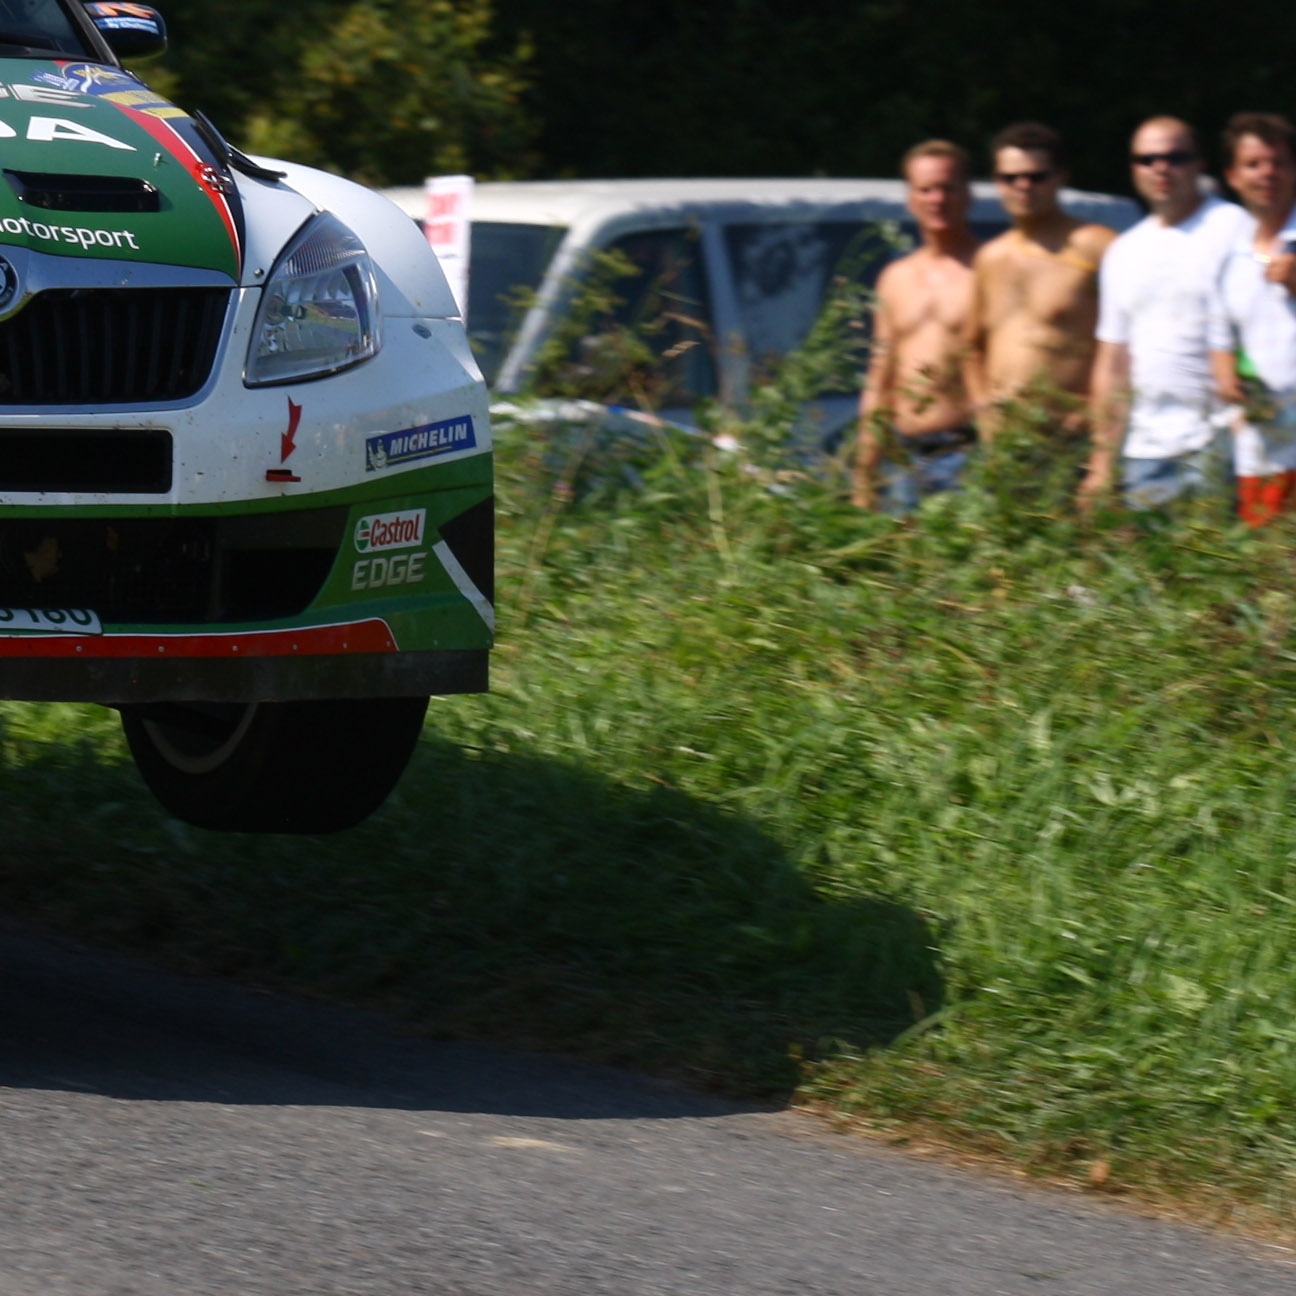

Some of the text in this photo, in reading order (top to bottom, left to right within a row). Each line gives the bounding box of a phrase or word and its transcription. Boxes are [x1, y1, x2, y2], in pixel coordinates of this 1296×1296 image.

[389, 423, 468, 457] MICHELIN
[370, 513, 421, 547] Castrol
[351, 551, 429, 591] EDGE
